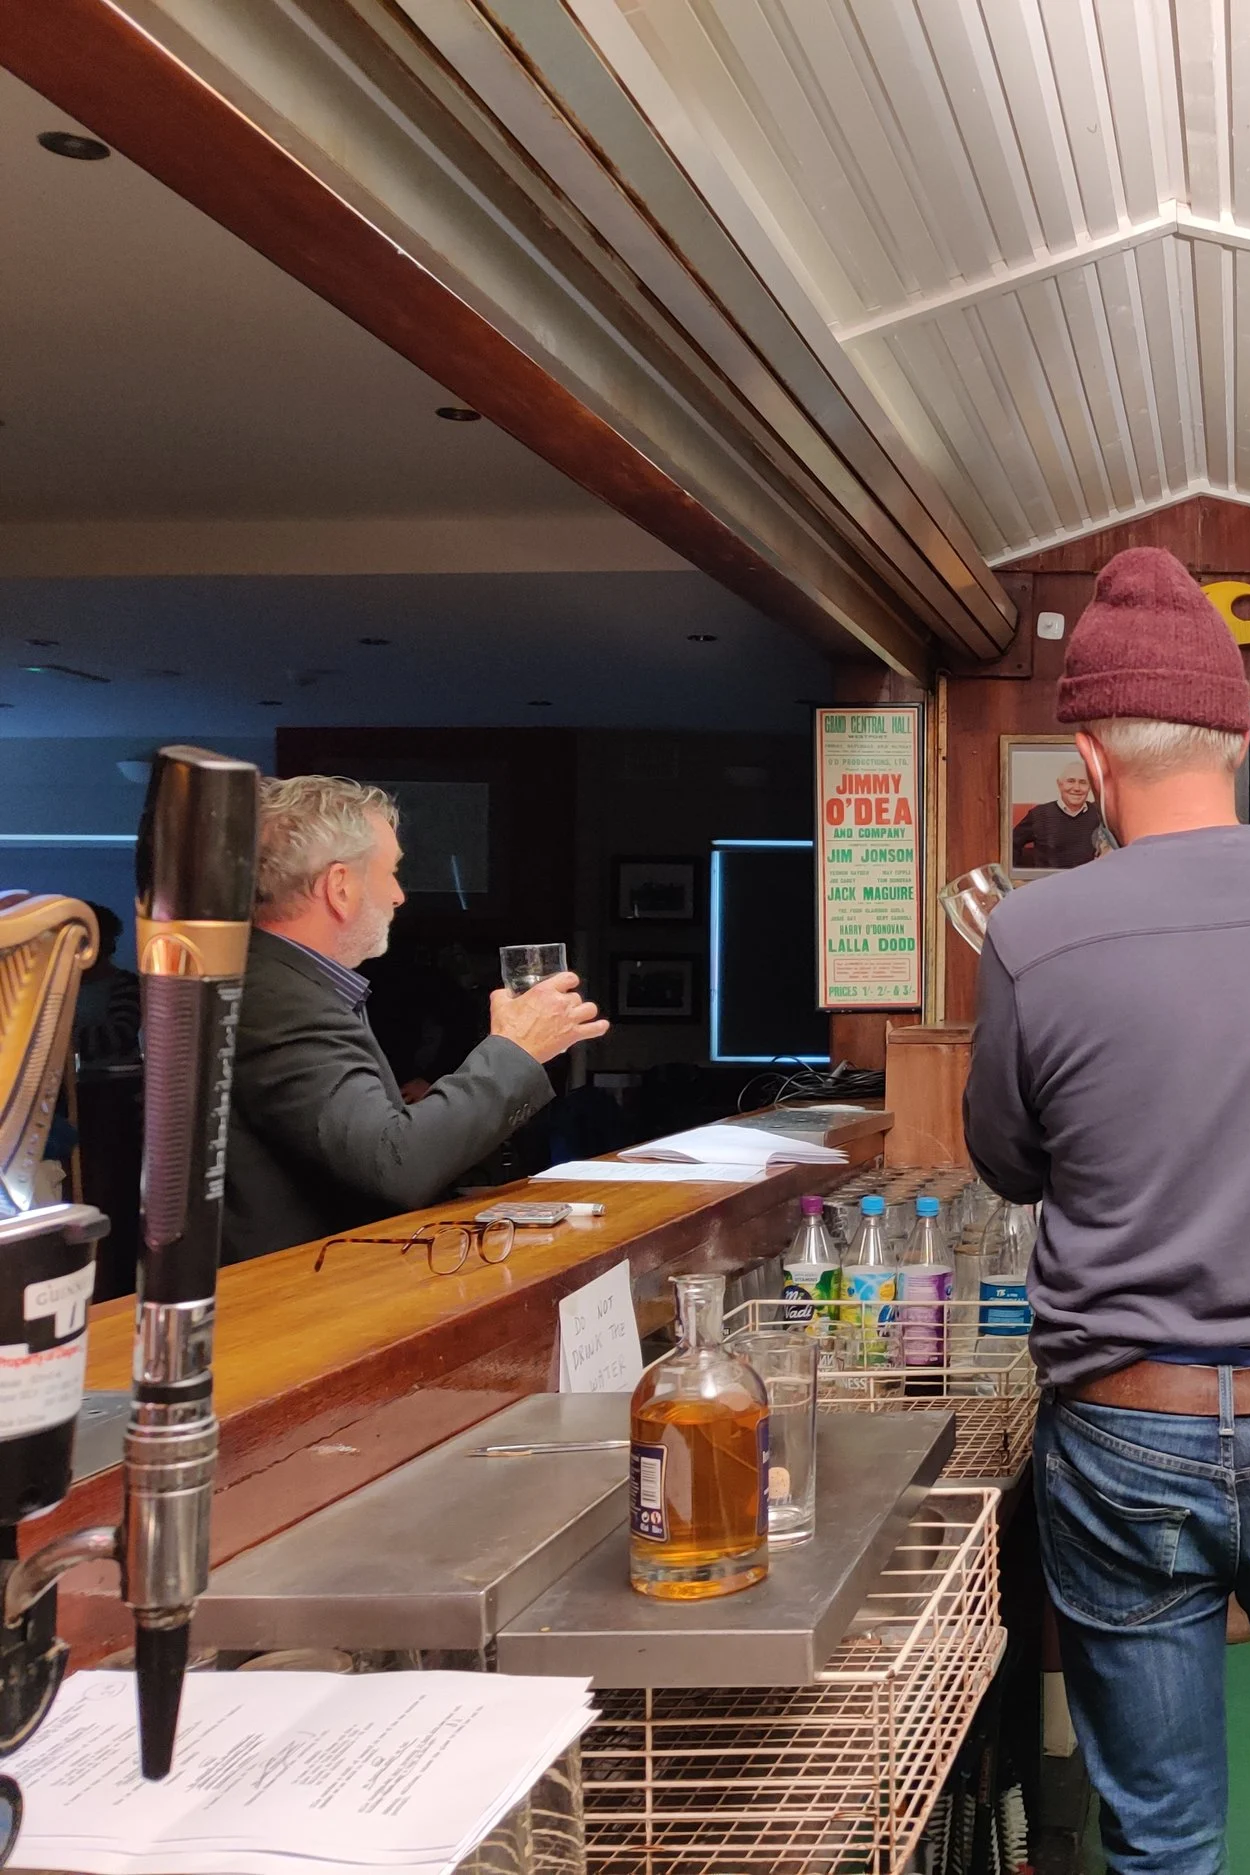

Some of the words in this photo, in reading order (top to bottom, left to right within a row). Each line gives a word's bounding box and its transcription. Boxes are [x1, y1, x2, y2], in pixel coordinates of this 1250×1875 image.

[851, 715, 888, 734] CENTRAL
[892, 715, 912, 734] HALL
[836, 773, 902, 794] JIMMY
[826, 797, 913, 826] O'DEA
[834, 828, 853, 839] AND
[858, 827, 906, 839] COMPANY
[827, 848, 853, 863] JIM
[861, 848, 914, 863] JONSON
[827, 886, 856, 901] JACK
[863, 886, 914, 900] MAGUIRE
[839, 924, 862, 935] HARRY
[865, 924, 905, 935] O'DONOVAN
[828, 938, 870, 952] LALLA
[878, 937, 916, 952] DODD
[828, 986, 858, 997] PRICES
[574, 1316, 586, 1336] DO
[597, 1295, 614, 1320] NOT
[571, 1331, 603, 1371] DRINK
[608, 1321, 625, 1340] THE
[589, 1359, 627, 1393] WATER
